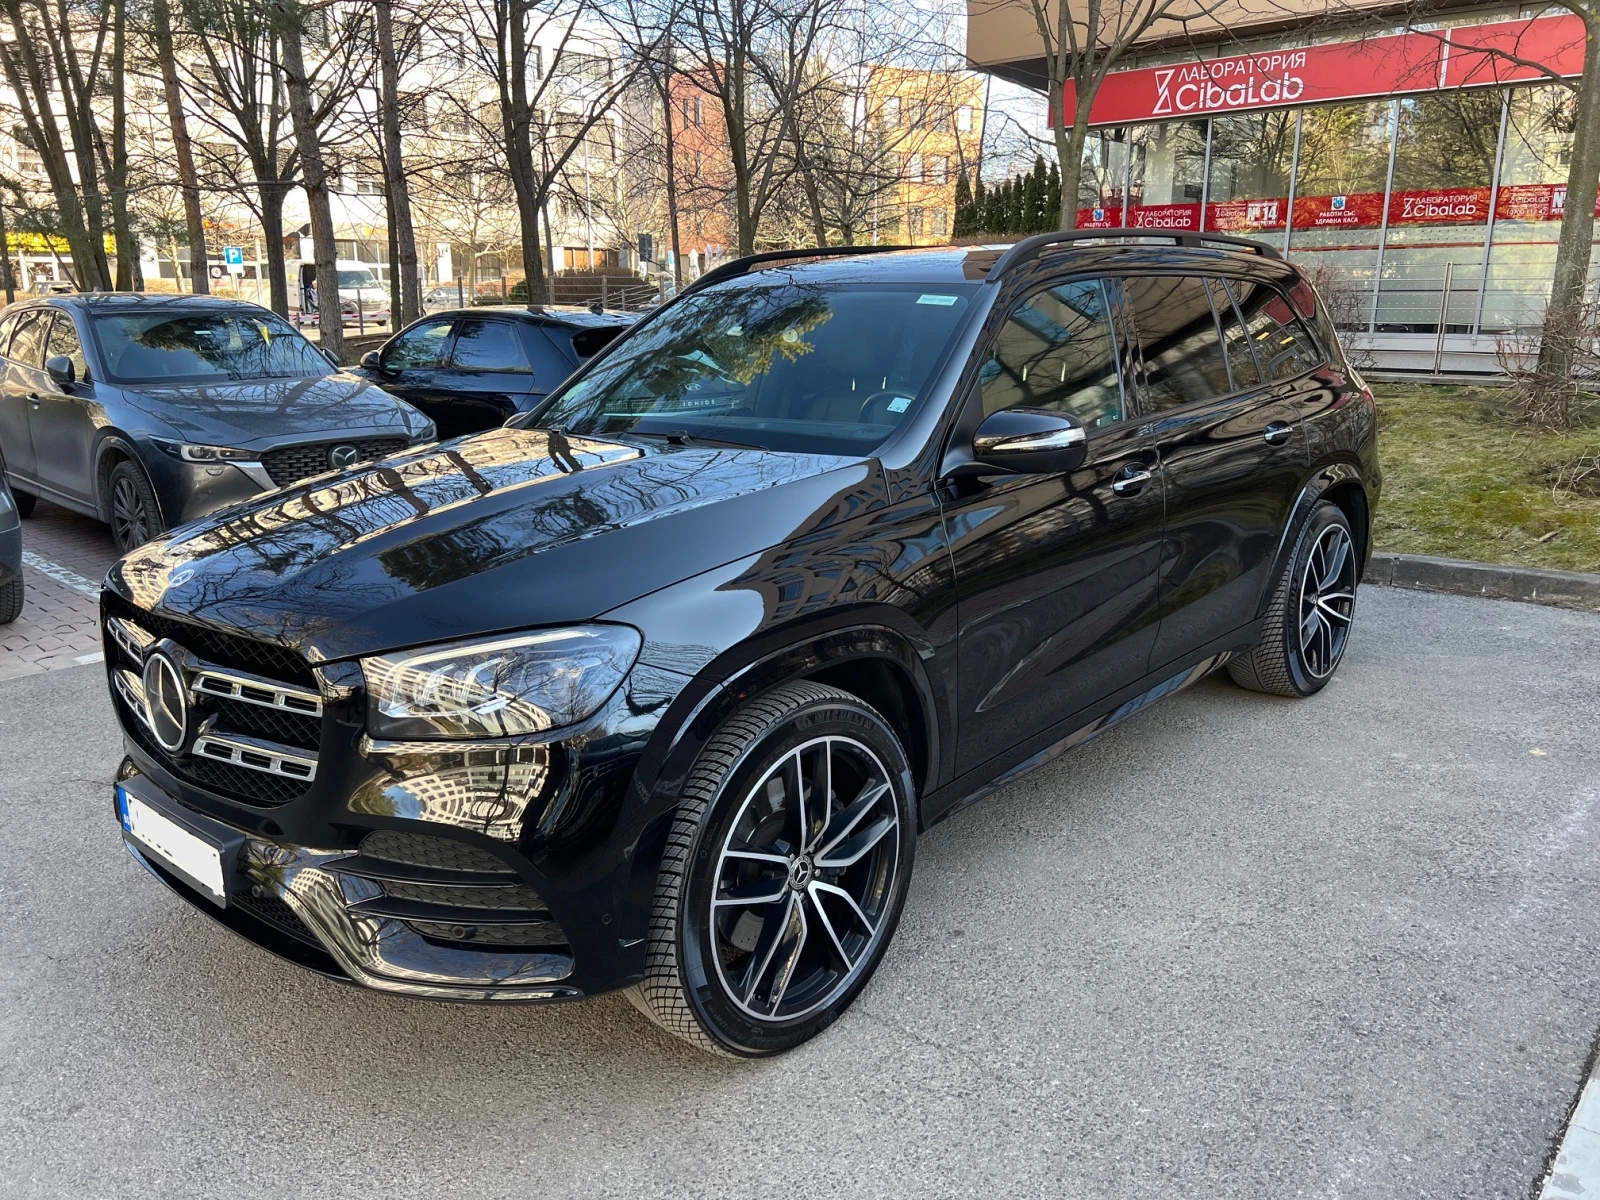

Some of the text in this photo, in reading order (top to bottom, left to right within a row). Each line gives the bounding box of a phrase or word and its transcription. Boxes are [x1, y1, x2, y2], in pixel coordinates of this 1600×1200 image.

[1178, 52, 1307, 83] ЛАБОРАТОРИЯ
[1175, 72, 1304, 111] CibaLab
[1415, 194, 1477, 204] ЛАБОРАТОРИЯ
[1145, 209, 1192, 217] ЛАБОРАТОРИЯ
[1262, 205, 1277, 220] 14
[1413, 203, 1476, 217] CibaLab
[1144, 217, 1191, 228] CibaLab
[228, 249, 239, 262] P
